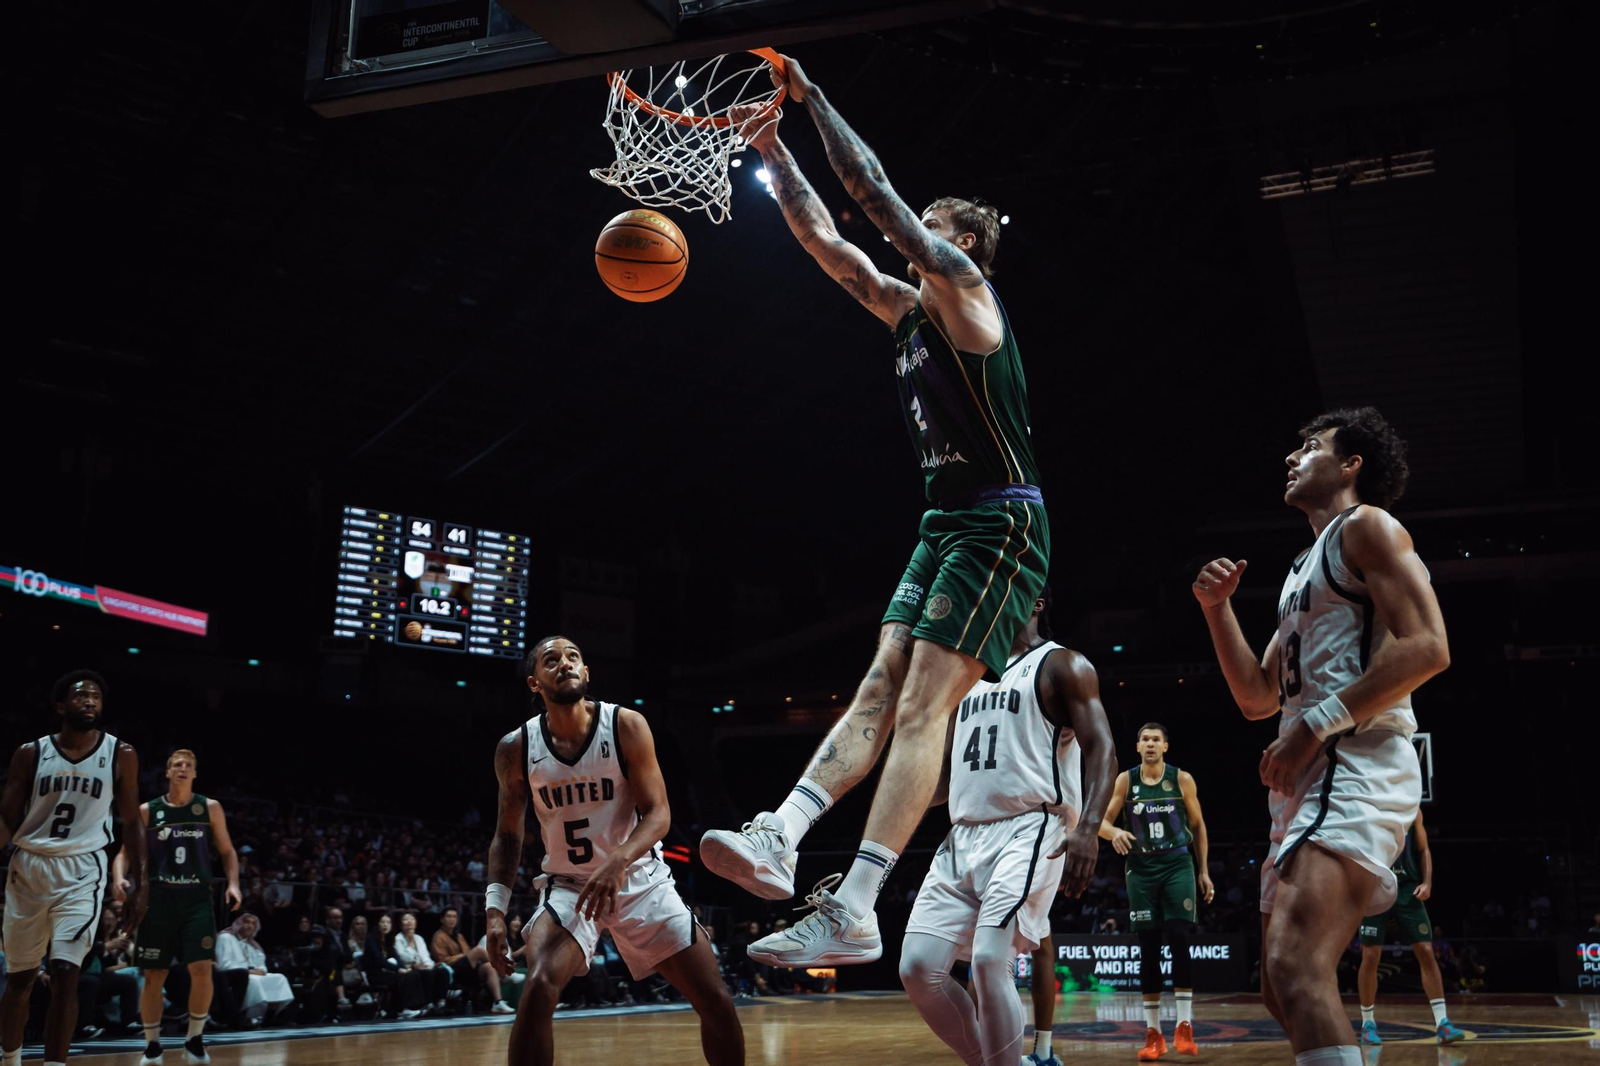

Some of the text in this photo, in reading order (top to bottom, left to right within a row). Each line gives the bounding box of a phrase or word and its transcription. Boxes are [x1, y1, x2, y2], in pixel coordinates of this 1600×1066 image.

[403, 17, 480, 38] INTERCONTINENTAL
[402, 37, 419, 48] CUP
[906, 346, 929, 373] icaja
[910, 395, 928, 431] 2
[920, 442, 970, 468] dalucía
[411, 521, 432, 538] 54
[447, 528, 466, 544] 41
[906, 591, 920, 600] SOL
[419, 598, 451, 616] 10.2
[960, 687, 1021, 723] UNITED
[963, 724, 998, 772] 41
[39, 774, 104, 800] UNITED
[538, 777, 614, 810] UNITED
[1146, 803, 1175, 814] Unicaja
[49, 802, 77, 840] 2
[1148, 821, 1164, 839] 19
[172, 829, 205, 839] Unicaja
[563, 817, 594, 866] 5
[174, 846, 187, 865] 9
[1058, 945, 1091, 959] FUEL
[1091, 945, 1130, 959] YOUR
[1578, 942, 1600, 962] 10
[1094, 960, 1124, 975] AND
[1583, 962, 1600, 972] PL
